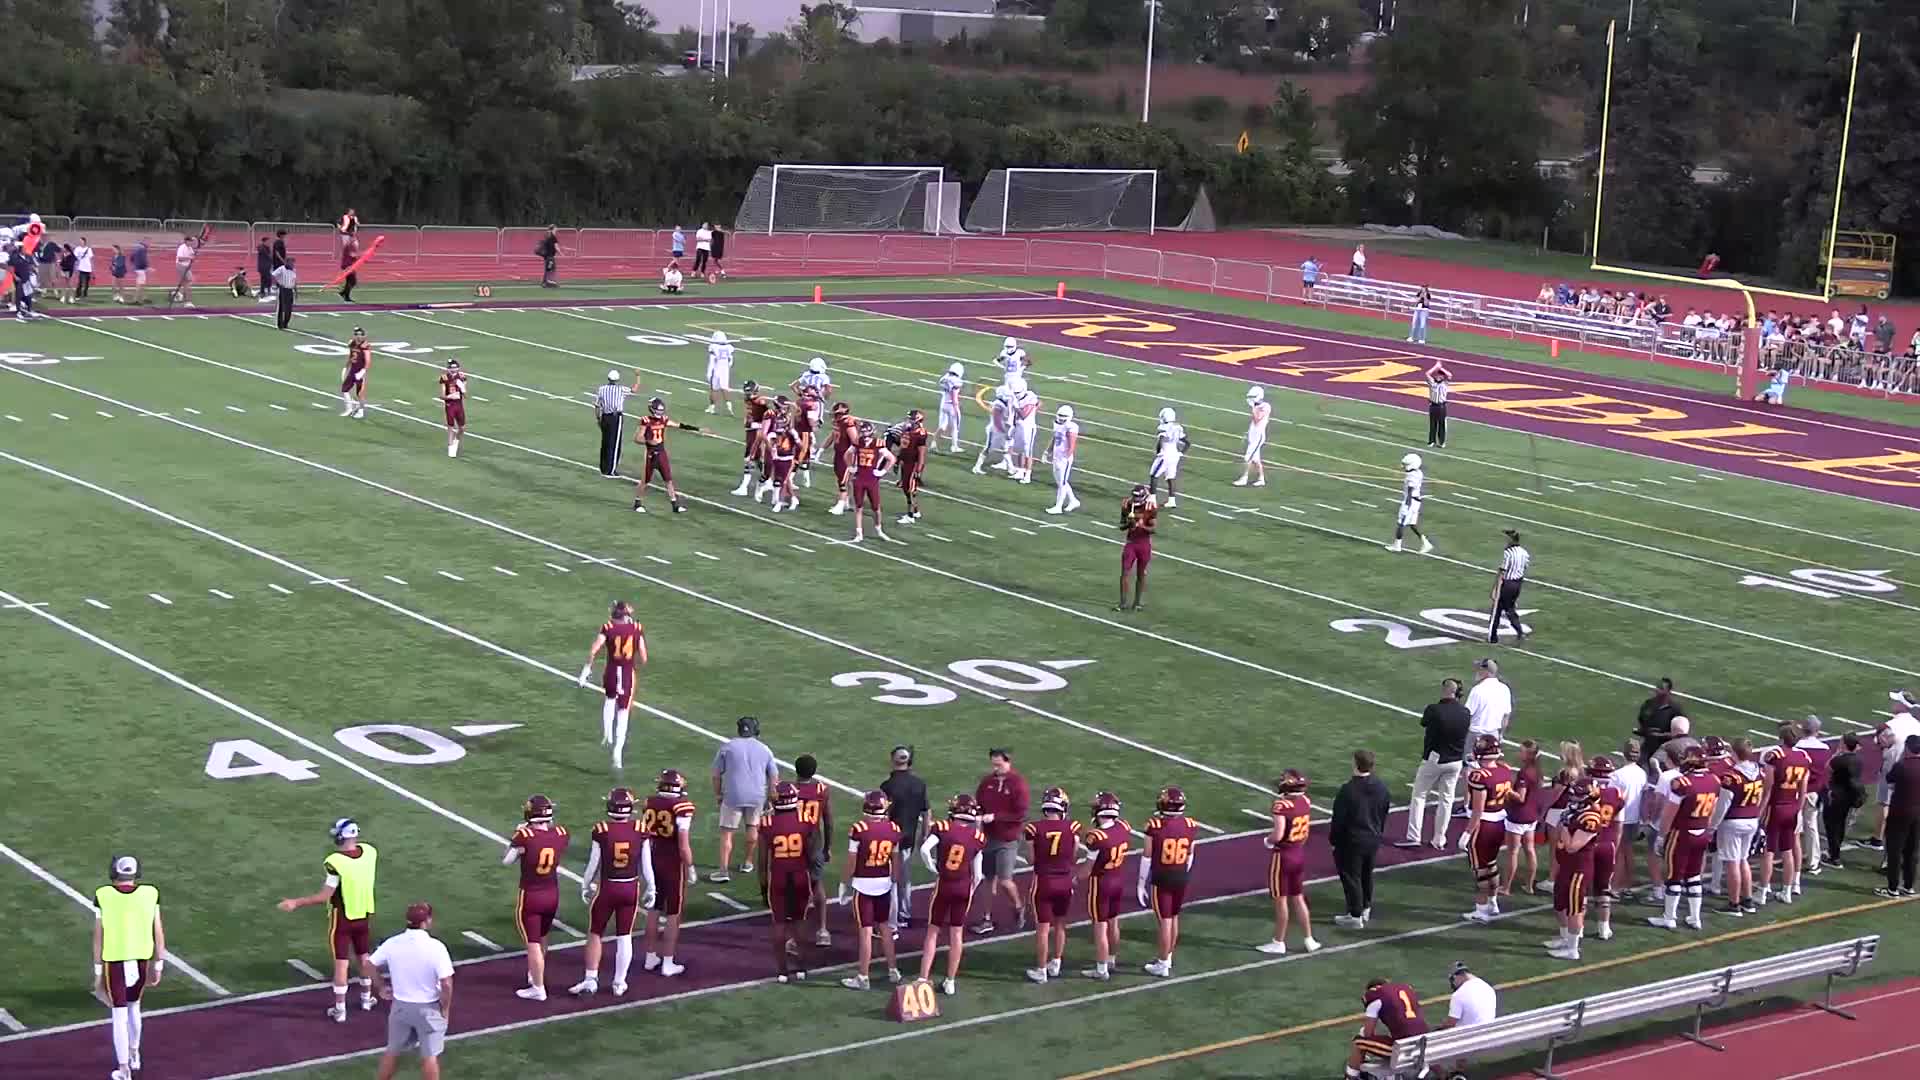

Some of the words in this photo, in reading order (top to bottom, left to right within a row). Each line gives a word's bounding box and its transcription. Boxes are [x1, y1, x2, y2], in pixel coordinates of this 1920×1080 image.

[613, 635, 634, 659] 14
[831, 659, 1068, 706] 30
[205, 724, 467, 781] 40
[642, 808, 673, 838] 23
[613, 841, 630, 868] 5
[773, 833, 803, 859] 29
[1046, 831, 1062, 856] 7
[536, 848, 555, 876] 0
[903, 982, 936, 1018] 40
[1399, 990, 1417, 1019] 1
